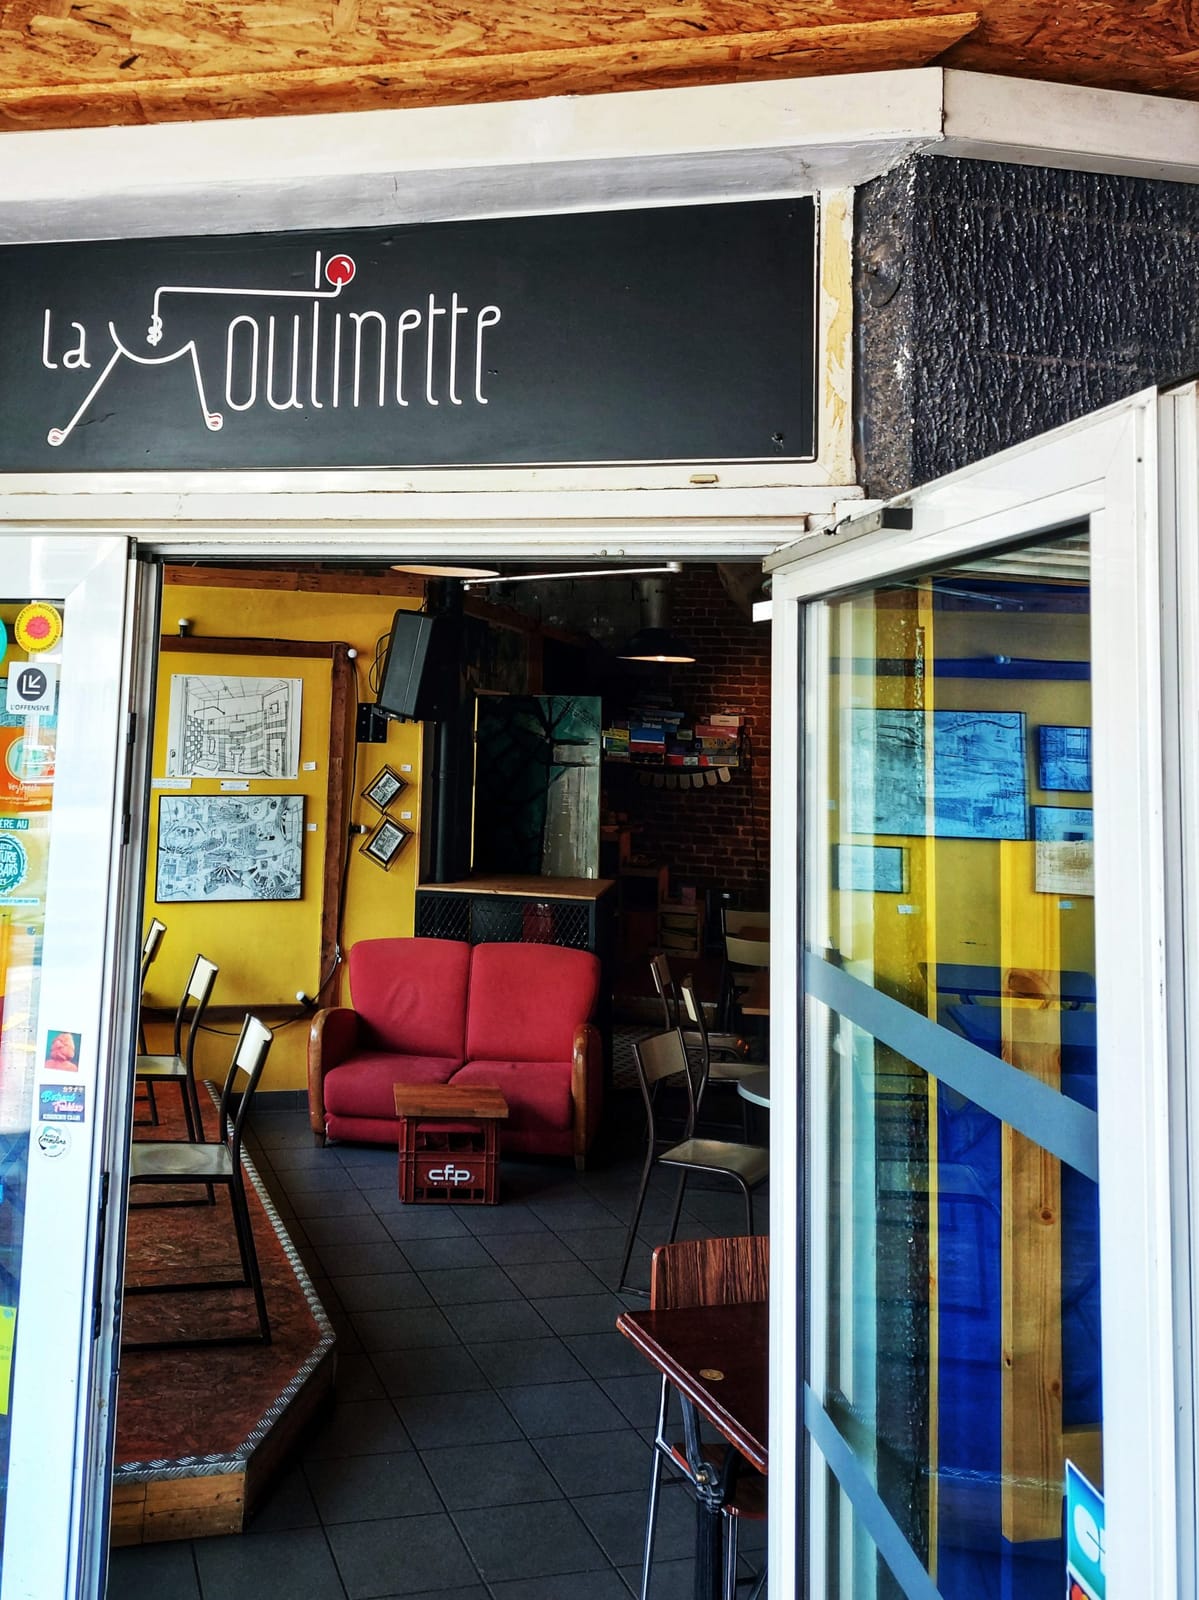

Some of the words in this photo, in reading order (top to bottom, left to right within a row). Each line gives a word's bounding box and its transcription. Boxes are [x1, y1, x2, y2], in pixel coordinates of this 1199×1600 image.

[43, 308, 91, 369] la
[10, 704, 50, 712] L'OFFENSIVE
[16, 819, 28, 829] AU
[428, 1164, 471, 1186] cfp
